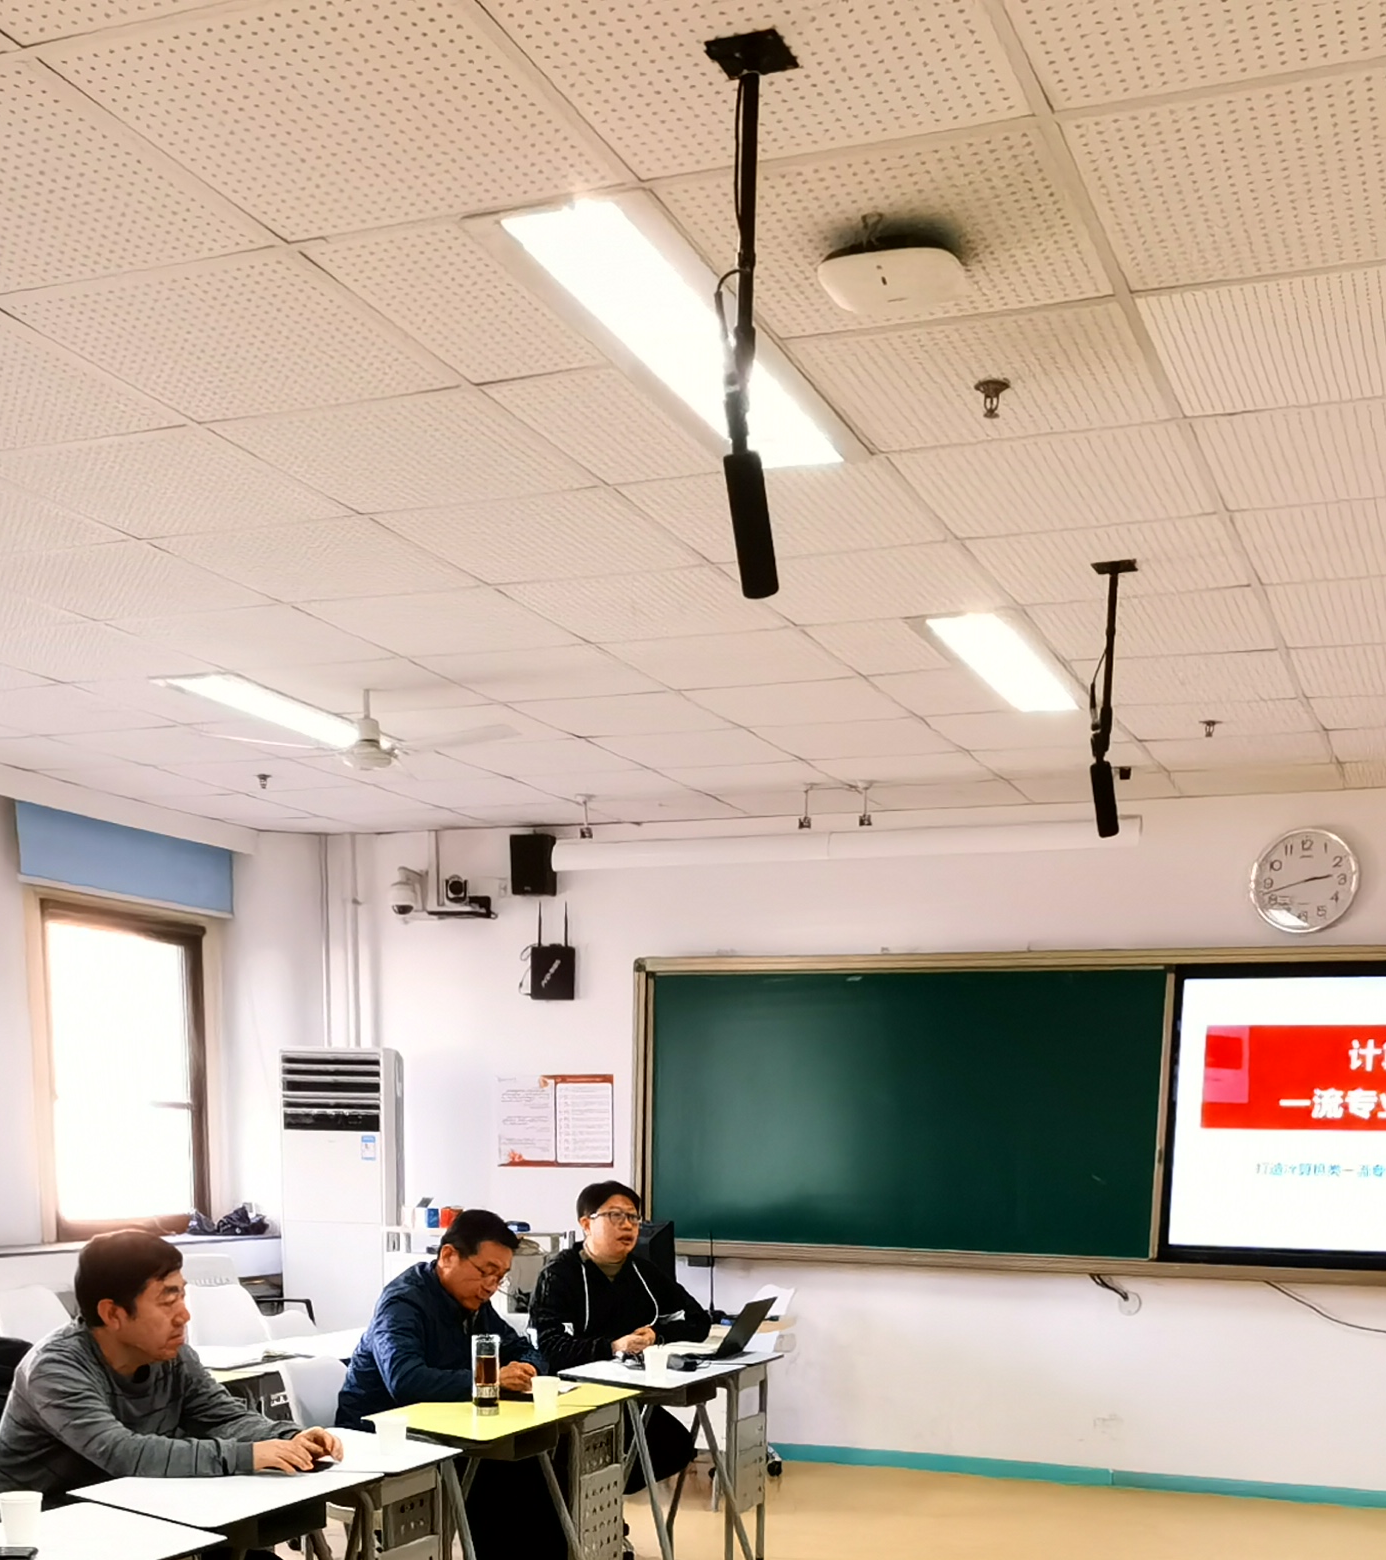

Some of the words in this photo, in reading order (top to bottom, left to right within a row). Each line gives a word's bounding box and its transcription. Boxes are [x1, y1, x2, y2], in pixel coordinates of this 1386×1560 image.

[1284, 844, 1293, 856] 11
[1269, 860, 1282, 871] 10
[1332, 856, 1343, 868] 2
[1263, 877, 1274, 889] 9
[1337, 874, 1347, 885] 3
[1330, 891, 1339, 904] 4
[1316, 905, 1327, 918] 5
